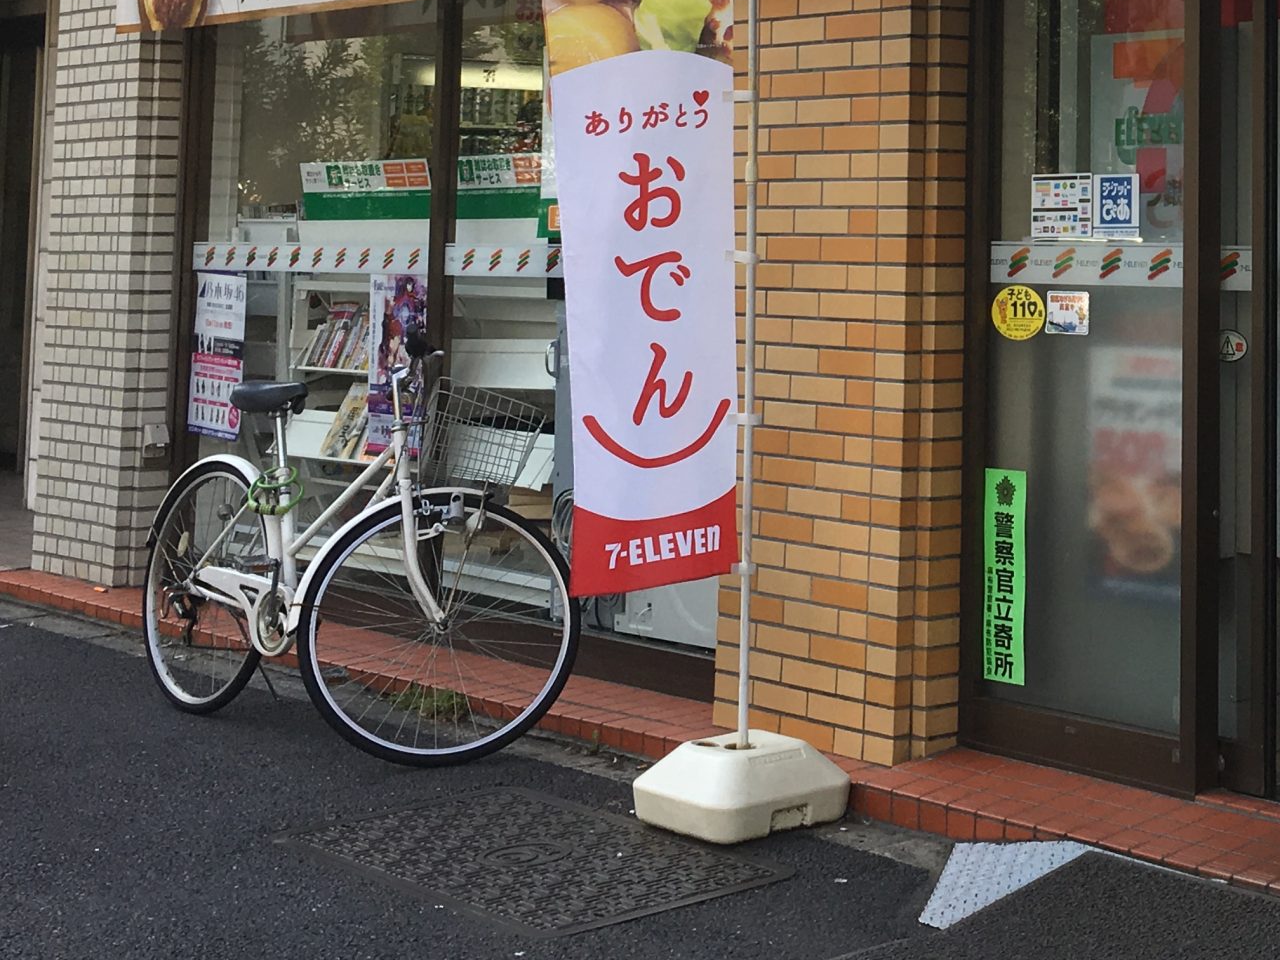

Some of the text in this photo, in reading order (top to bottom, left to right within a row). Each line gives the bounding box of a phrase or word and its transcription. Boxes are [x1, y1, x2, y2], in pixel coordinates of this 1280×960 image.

[584, 102, 710, 136] ありがとう
[1102, 180, 1131, 197] チケット
[1102, 198, 1131, 221] ぴあ
[614, 151, 693, 427] おでん
[1007, 288, 1032, 301] 子ども
[993, 511, 1015, 680] 警察官立寄所
